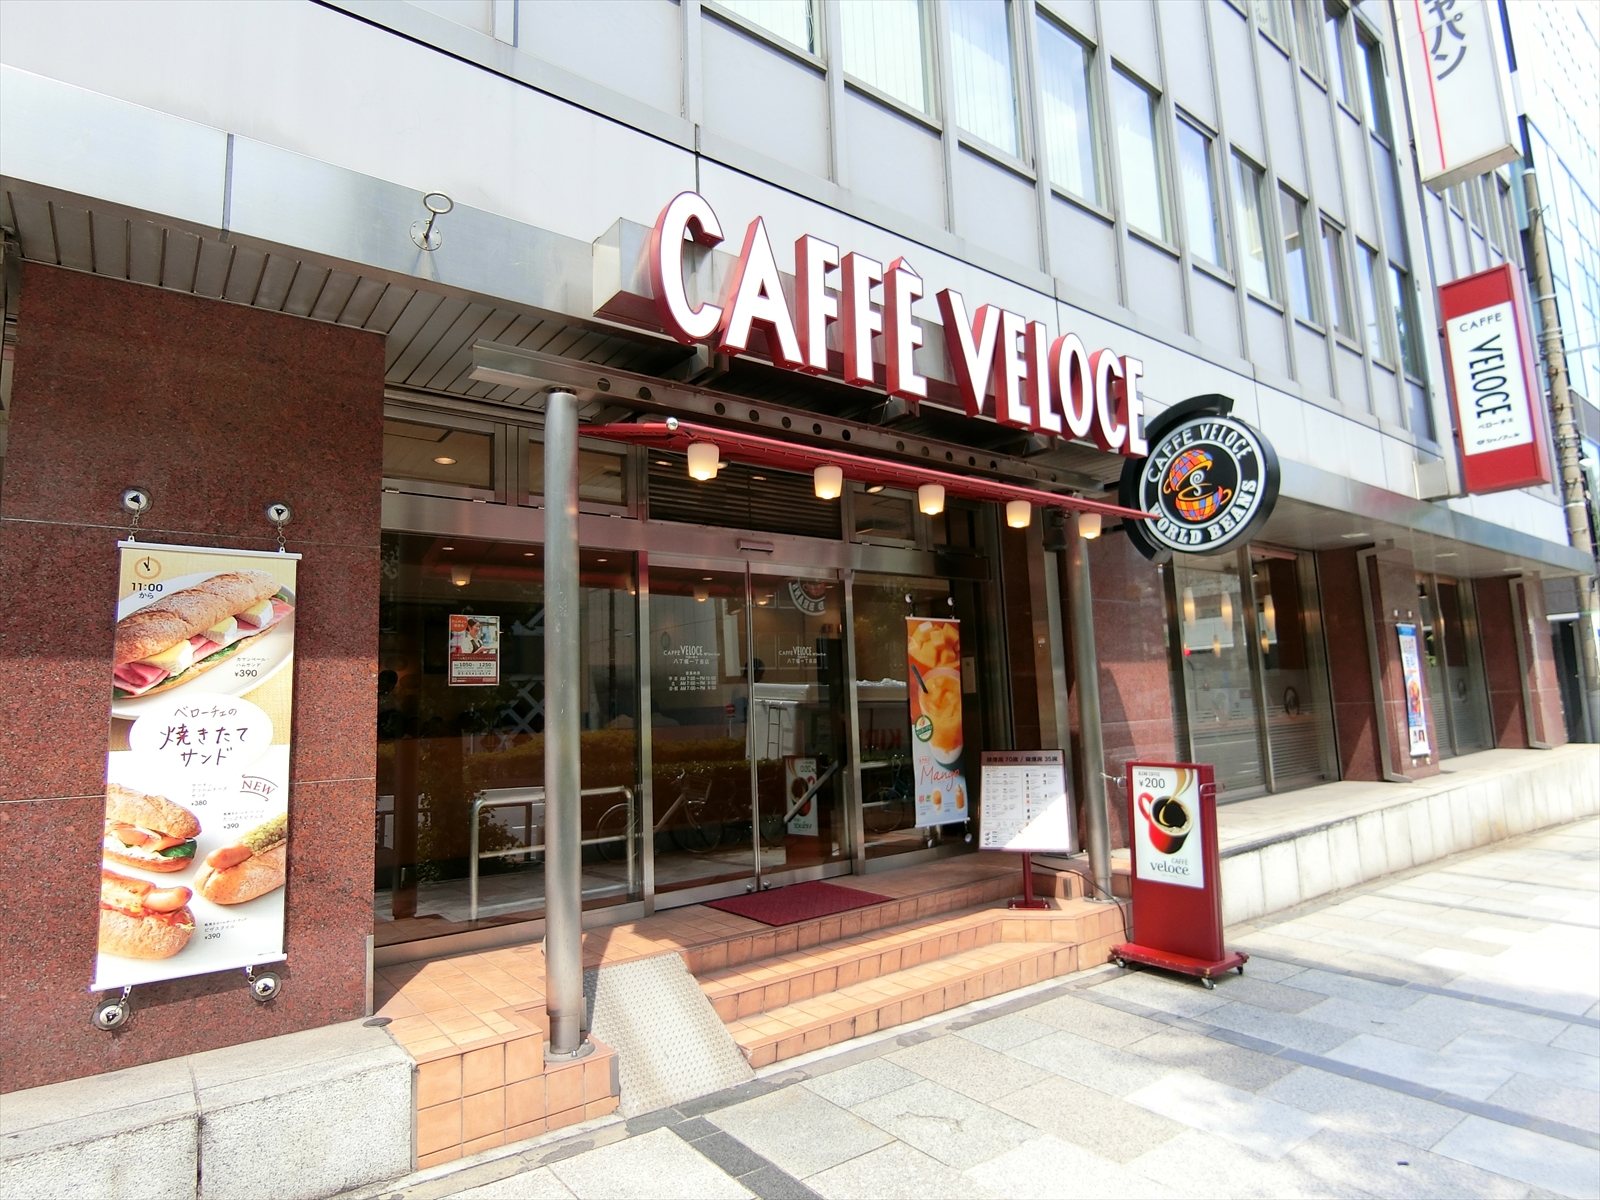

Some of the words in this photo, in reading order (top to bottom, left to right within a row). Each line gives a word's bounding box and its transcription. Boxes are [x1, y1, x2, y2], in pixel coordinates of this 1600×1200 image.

[1458, 311, 1503, 333] CAFFE
[936, 287, 1148, 458] VELOCE
[1468, 333, 1512, 419] VELOCE
[1200, 423, 1253, 459] VELOCE
[1148, 502, 1201, 544] WORLD
[1207, 479, 1257, 541] BEANS
[131, 582, 163, 592] 11:00
[680, 645, 703, 656] VELOCE
[792, 646, 812, 656] VELOCE
[235, 669, 258, 677] ¥390
[173, 705, 238, 718] ベローチェの
[159, 723, 249, 750] 焼きたて
[180, 747, 233, 768] サンド
[241, 780, 276, 795] NEW
[920, 765, 960, 792] Mango
[1139, 777, 1166, 789] ¥200
[1149, 860, 1191, 876] veloce
